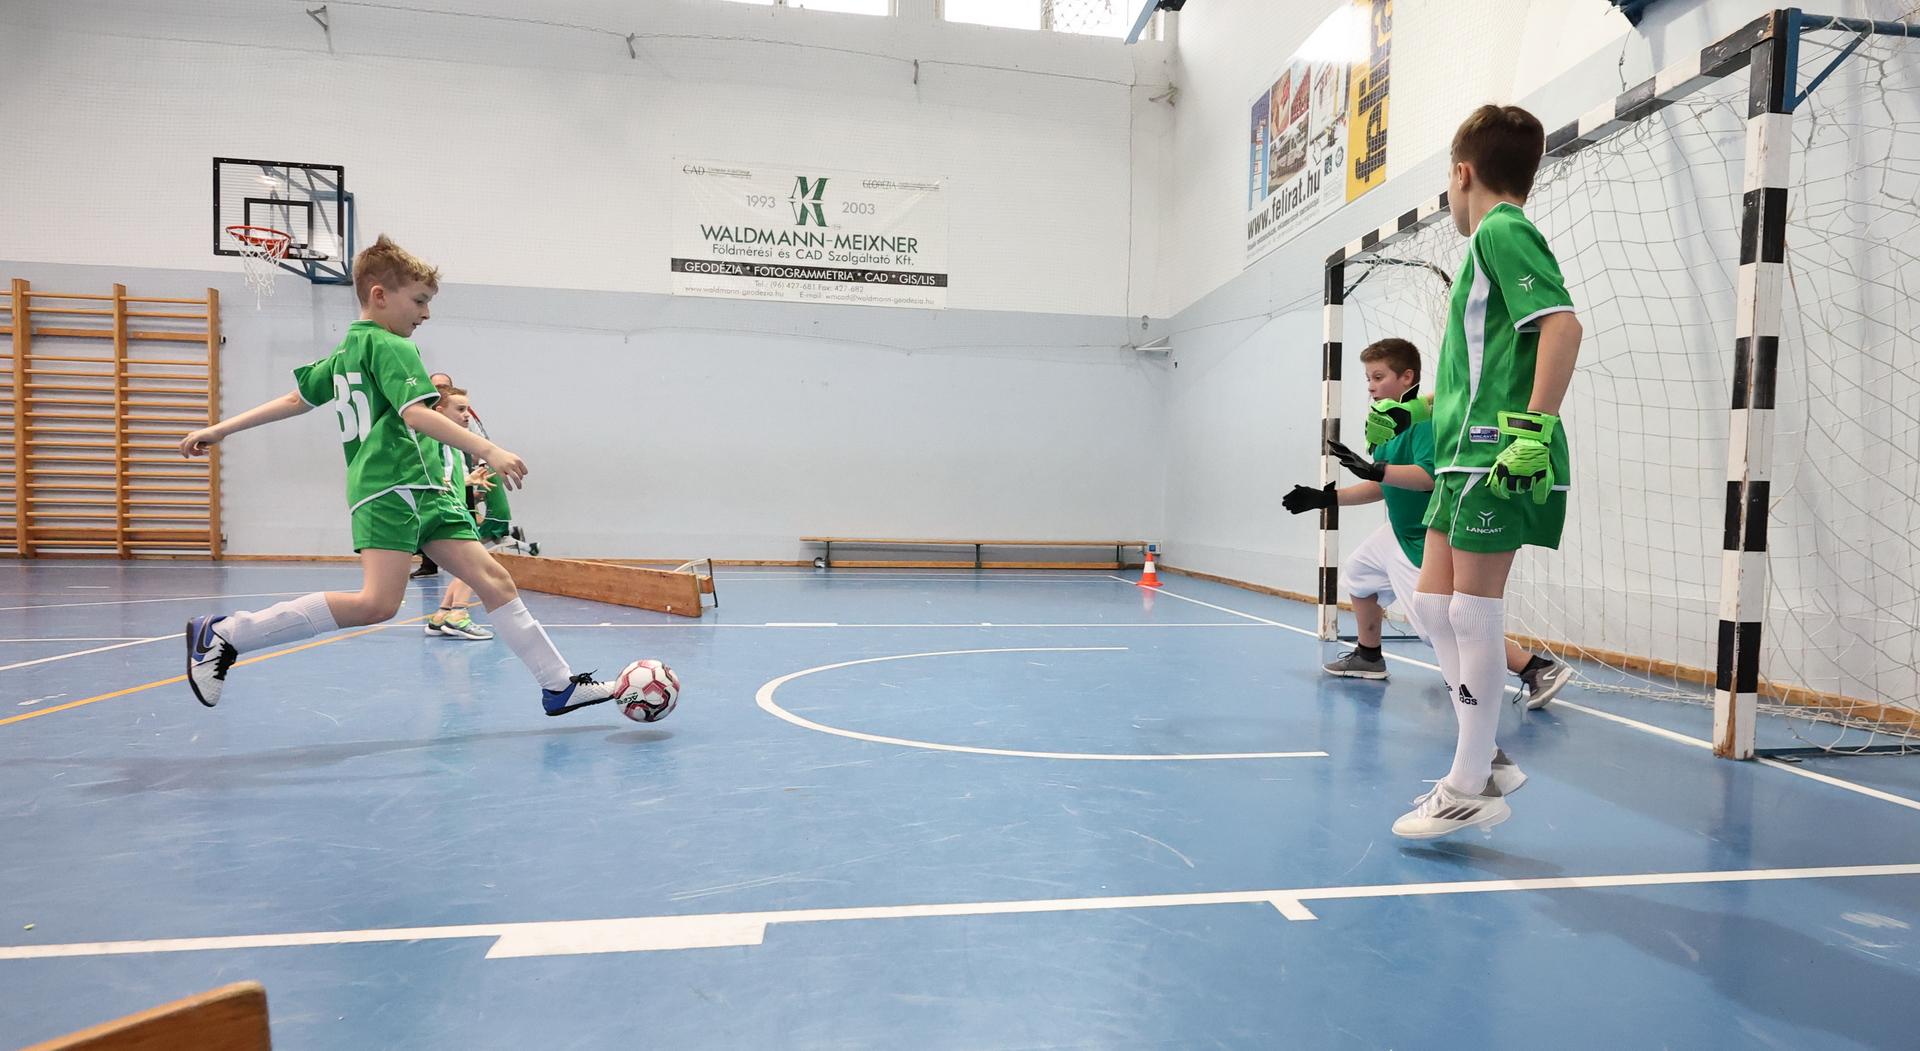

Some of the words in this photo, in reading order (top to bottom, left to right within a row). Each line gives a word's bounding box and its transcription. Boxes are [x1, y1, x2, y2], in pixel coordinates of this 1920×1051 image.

[683, 165, 705, 176] CAD
[746, 195, 776, 208] 1993
[842, 201, 875, 215] 2003
[1247, 169, 1321, 240] www.felirat.hu
[700, 224, 918, 254] WALDMANN-MEIXNER
[712, 243, 773, 258] Földmérési
[778, 249, 790, 259] és
[796, 248, 823, 260] CAD
[828, 251, 891, 265] Szolgáltató
[896, 255, 915, 266] Kft.
[684, 261, 743, 275] GEODÉZIA
[754, 266, 854, 281] FOTOGRAMMETRIA
[864, 272, 888, 283] CAD
[899, 274, 936, 286] GIS/LIS
[770, 281, 785, 289] (96)
[786, 282, 816, 290] 427-681
[834, 285, 864, 293] 427-682
[1466, 525, 1503, 535] LANCAST
